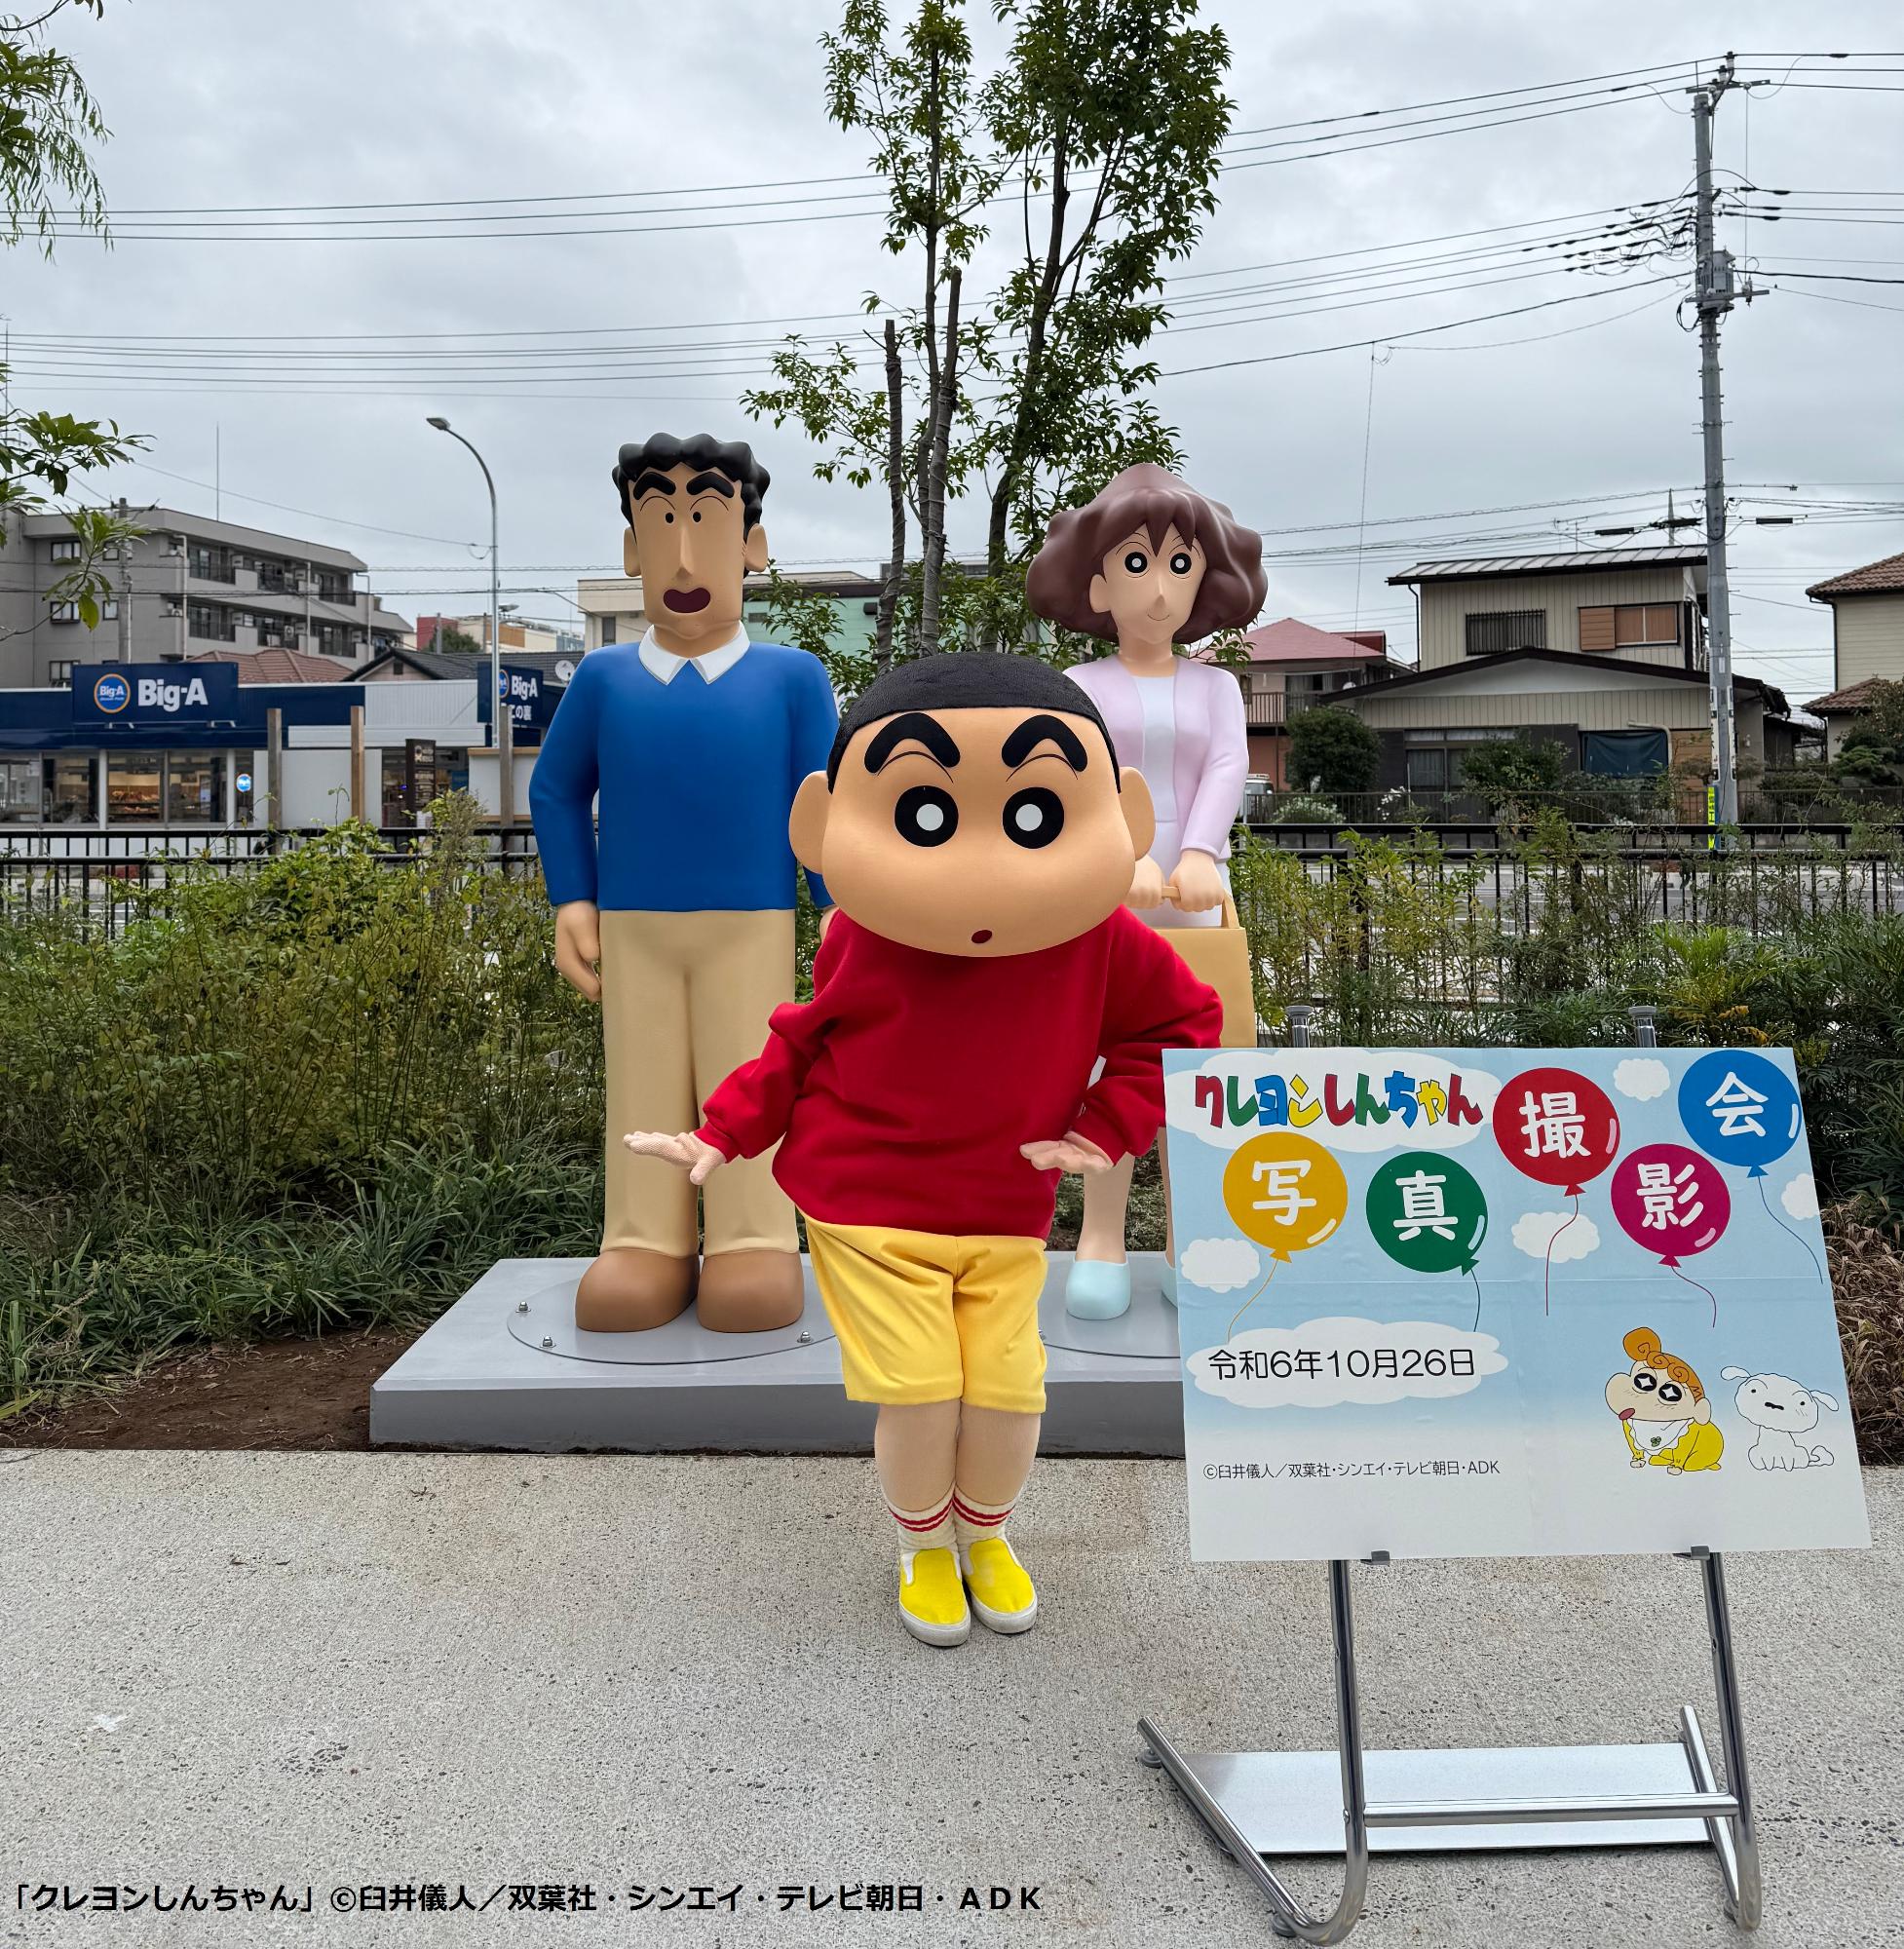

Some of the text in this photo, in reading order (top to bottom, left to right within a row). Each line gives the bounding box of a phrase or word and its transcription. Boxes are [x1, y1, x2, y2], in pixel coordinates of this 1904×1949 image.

[138, 678, 209, 711] Big-A
[512, 675, 538, 701] Big-A
[1195, 1070, 1483, 1128] クレヨンしんちゃん
[1208, 1349, 1474, 1380] 令和6年10月26日
